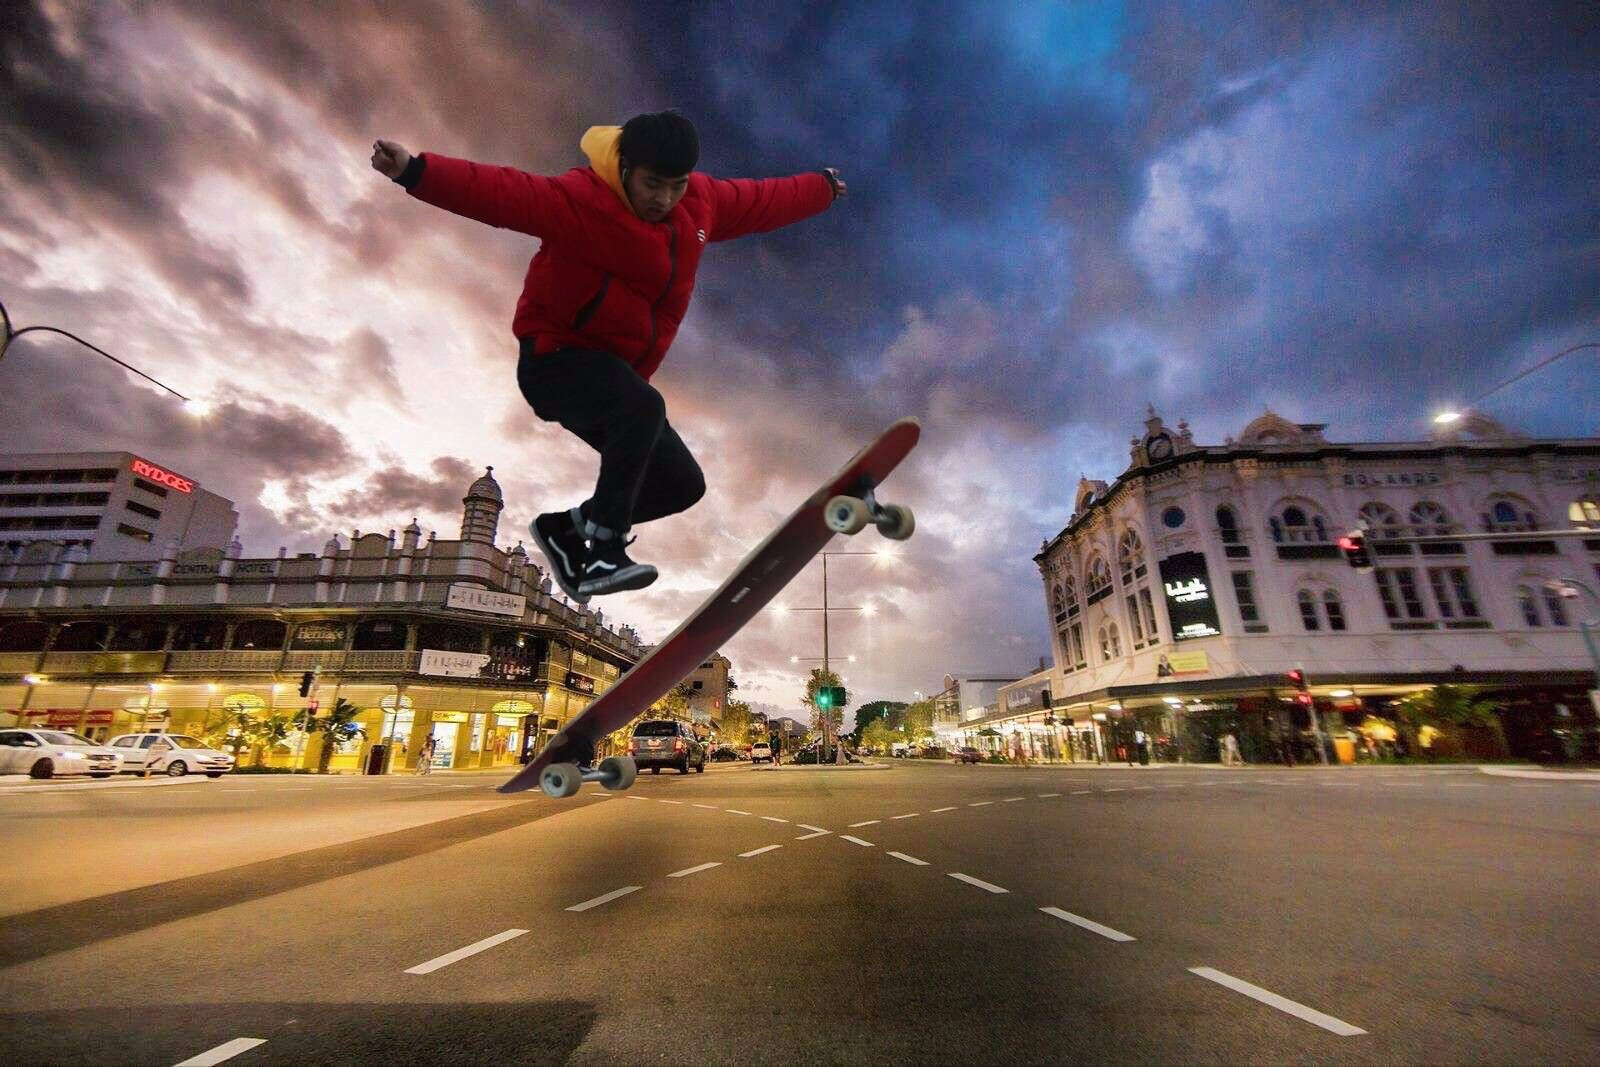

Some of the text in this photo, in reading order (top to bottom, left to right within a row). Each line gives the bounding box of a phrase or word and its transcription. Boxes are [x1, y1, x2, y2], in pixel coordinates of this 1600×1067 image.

[132, 459, 193, 494] RYDGES
[173, 563, 219, 574] CENTRAL
[234, 562, 275, 574] HOTEL
